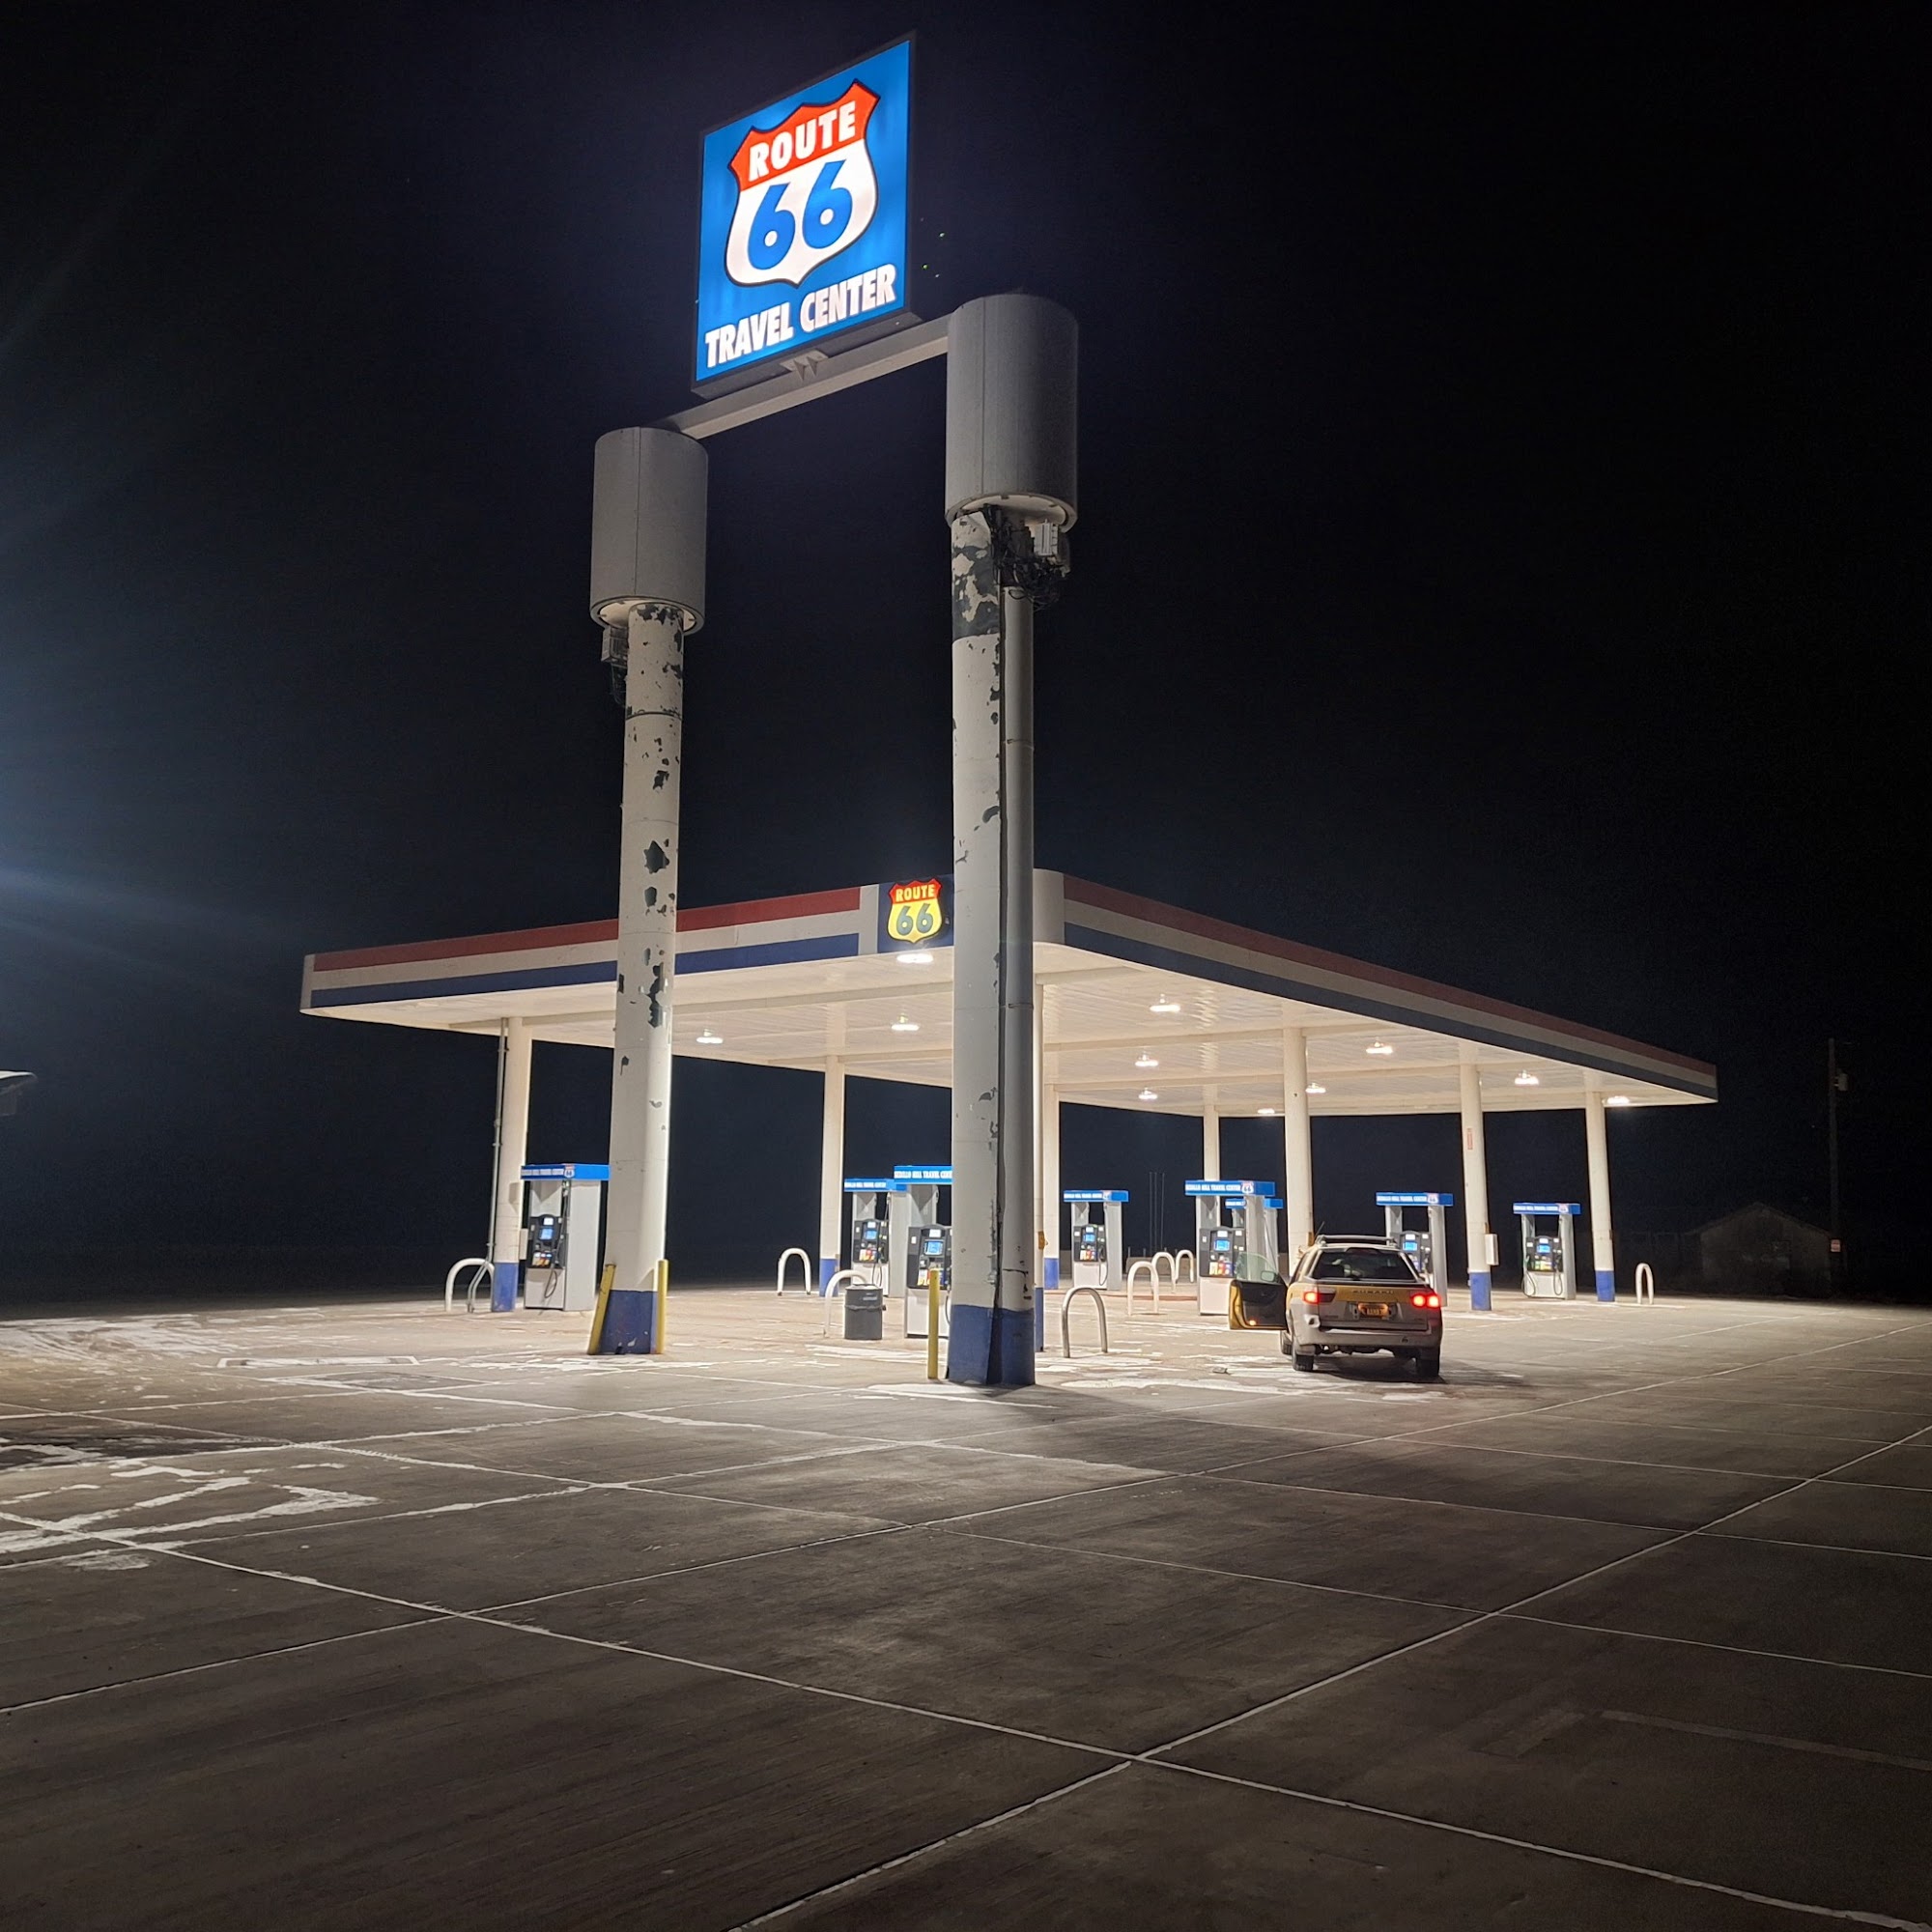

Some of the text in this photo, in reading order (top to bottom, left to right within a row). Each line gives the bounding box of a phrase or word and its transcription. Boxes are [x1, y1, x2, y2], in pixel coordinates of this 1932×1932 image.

[748, 99, 856, 182] ROUTE
[748, 158, 853, 270] 66
[705, 263, 896, 368] TRAVEL CENTER
[895, 884, 935, 902] ROUTE
[896, 903, 934, 936] 66
